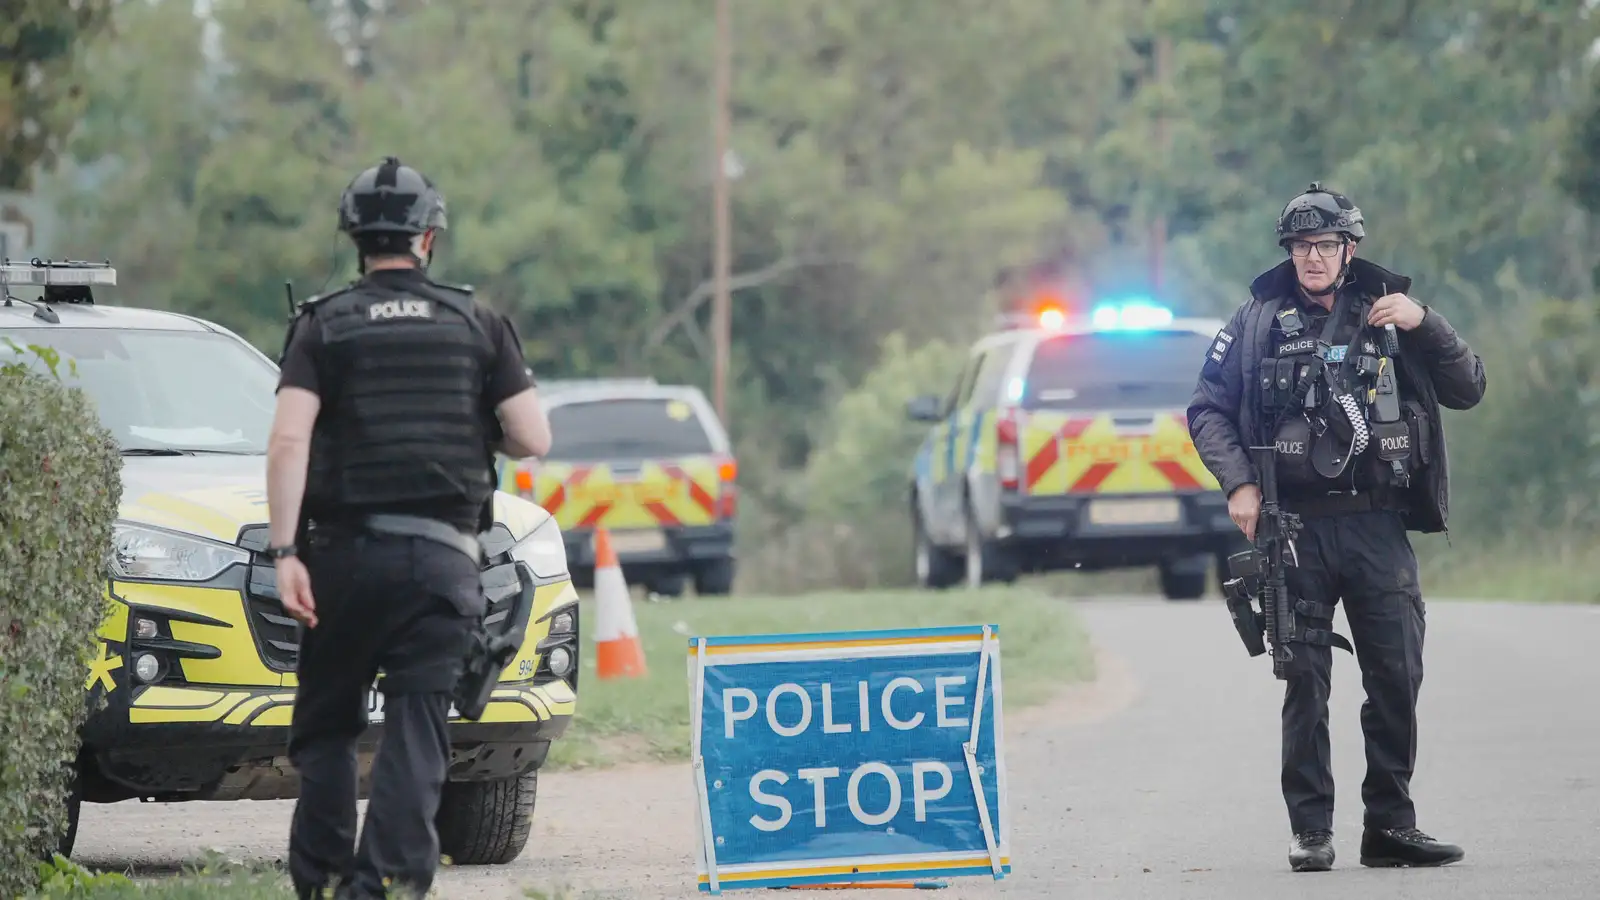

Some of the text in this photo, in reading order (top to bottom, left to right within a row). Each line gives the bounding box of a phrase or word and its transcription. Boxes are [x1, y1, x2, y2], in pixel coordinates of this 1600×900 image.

[369, 300, 431, 320] POLICE
[1218, 331, 1234, 344] POLICE
[1279, 340, 1314, 354] POLICE
[1275, 440, 1304, 455] POLICE
[1381, 435, 1409, 450] POLICE
[722, 676, 970, 738] POLICE
[748, 761, 953, 832] STOP
